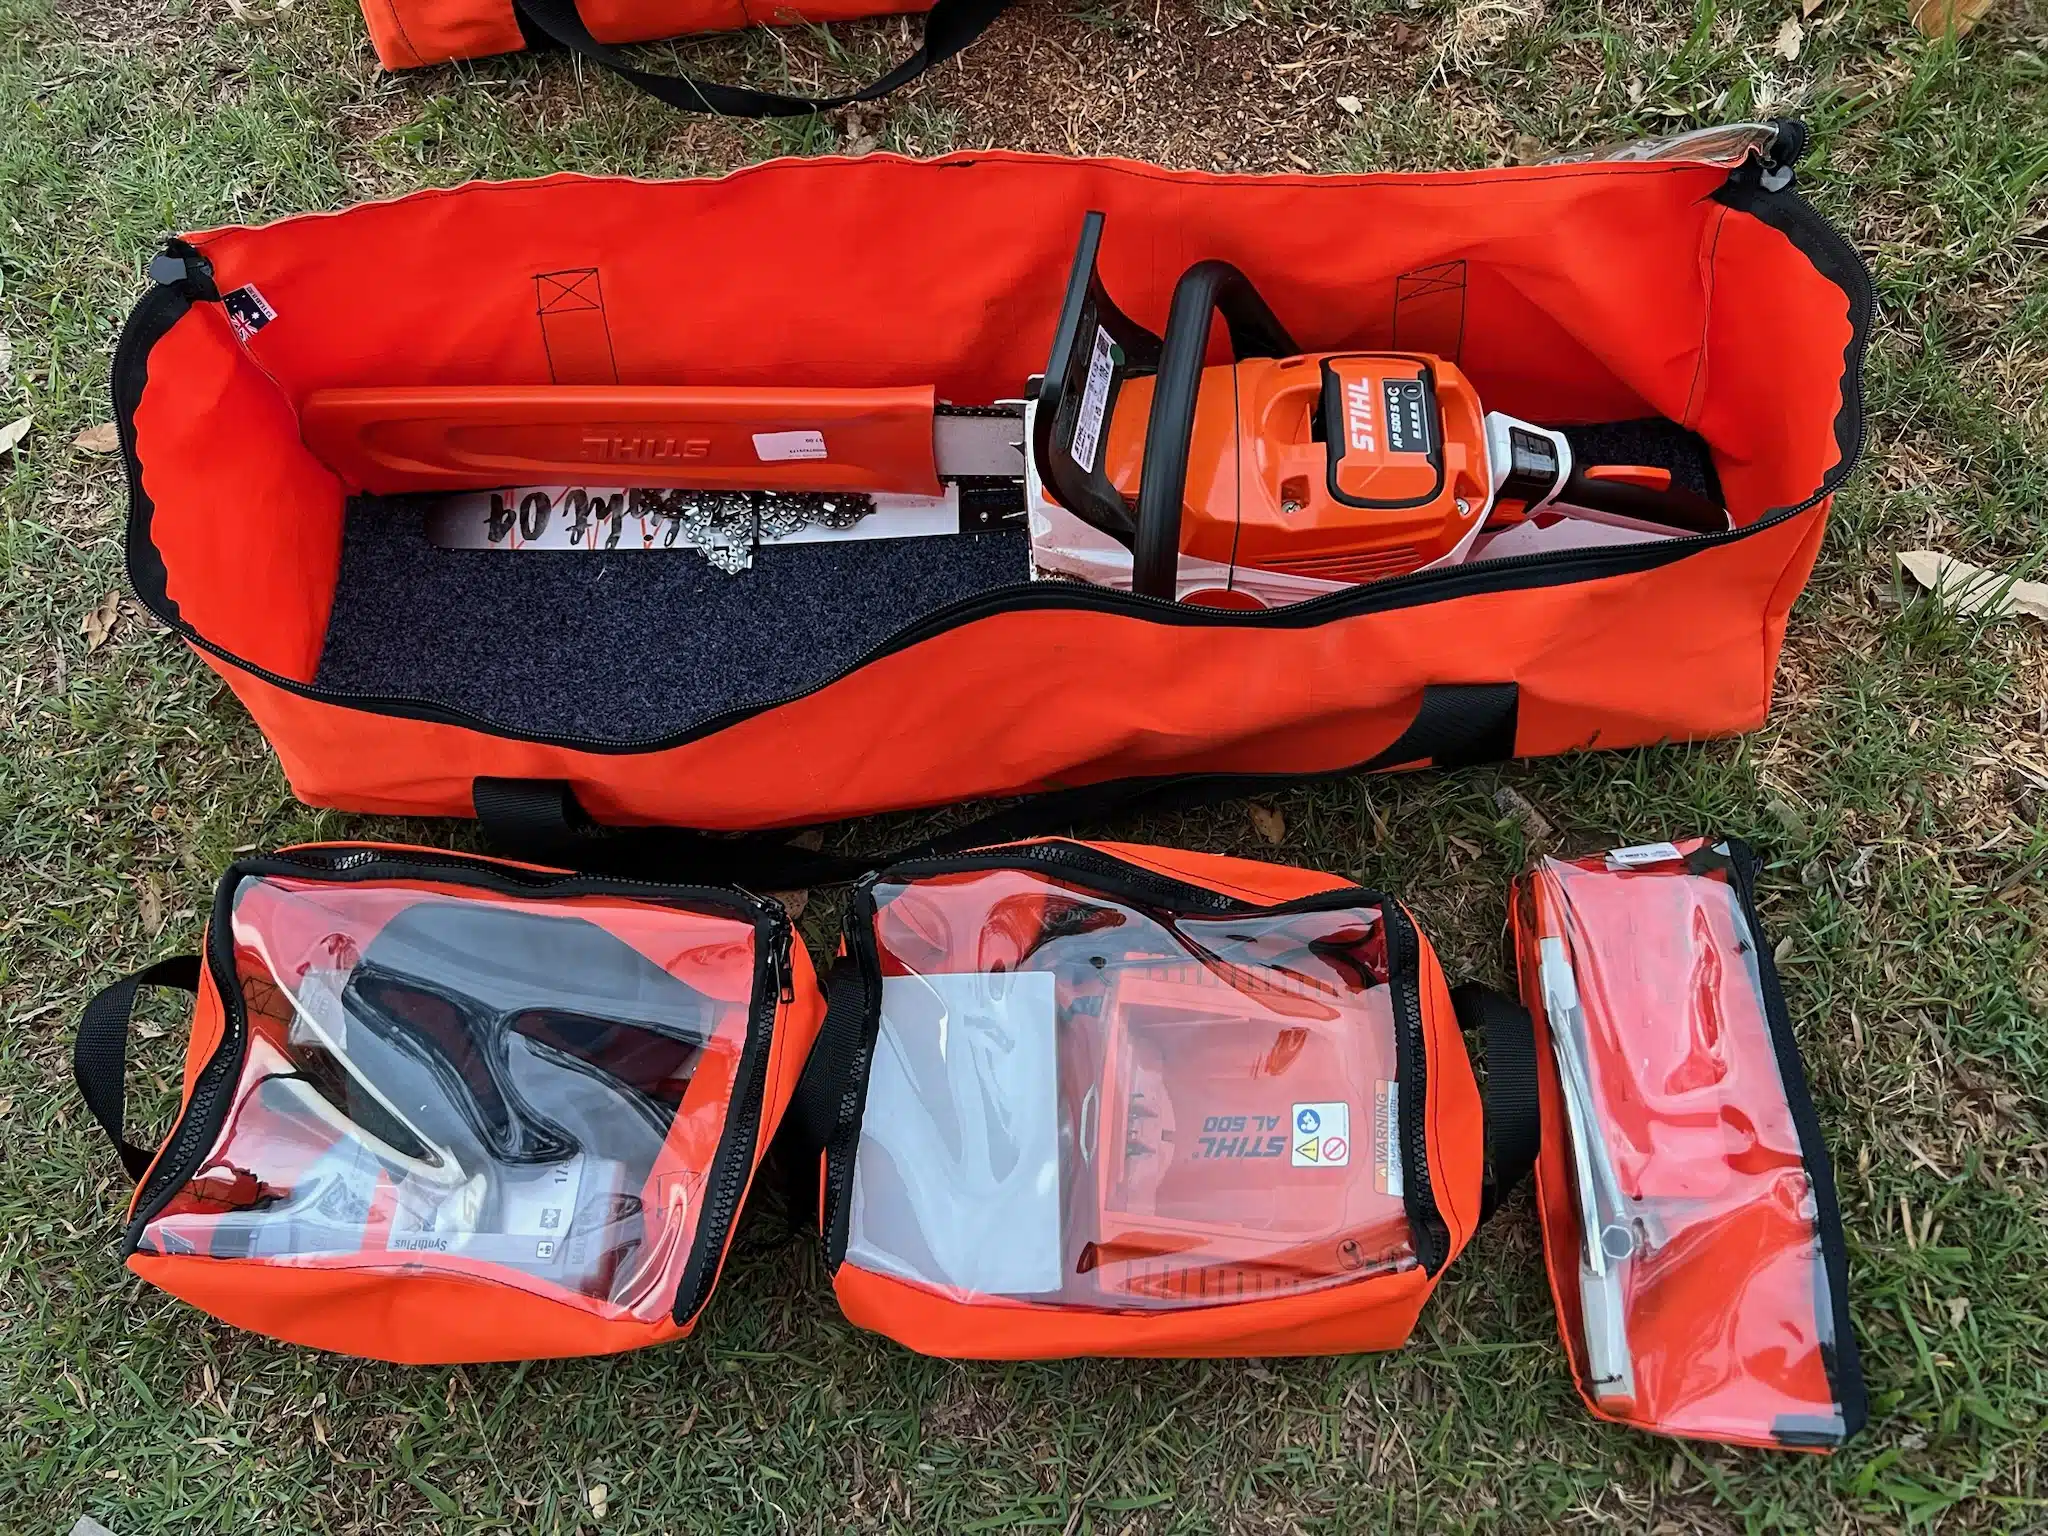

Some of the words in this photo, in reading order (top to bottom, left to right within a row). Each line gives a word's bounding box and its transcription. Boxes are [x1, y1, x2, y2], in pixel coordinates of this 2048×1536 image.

[1346, 377, 1375, 453] STIHL
[1391, 412, 1402, 433] 500
[581, 435, 711, 460] STIHL
[1392, 432, 1404, 448] AP
[1203, 1116, 1248, 1132] 500
[1252, 1115, 1281, 1132] AL
[1375, 1093, 1388, 1164] WARNING
[1389, 1119, 1397, 1140] ONLY
[1198, 1136, 1288, 1158] STIHL
[394, 1238, 448, 1252] SynthPlus
